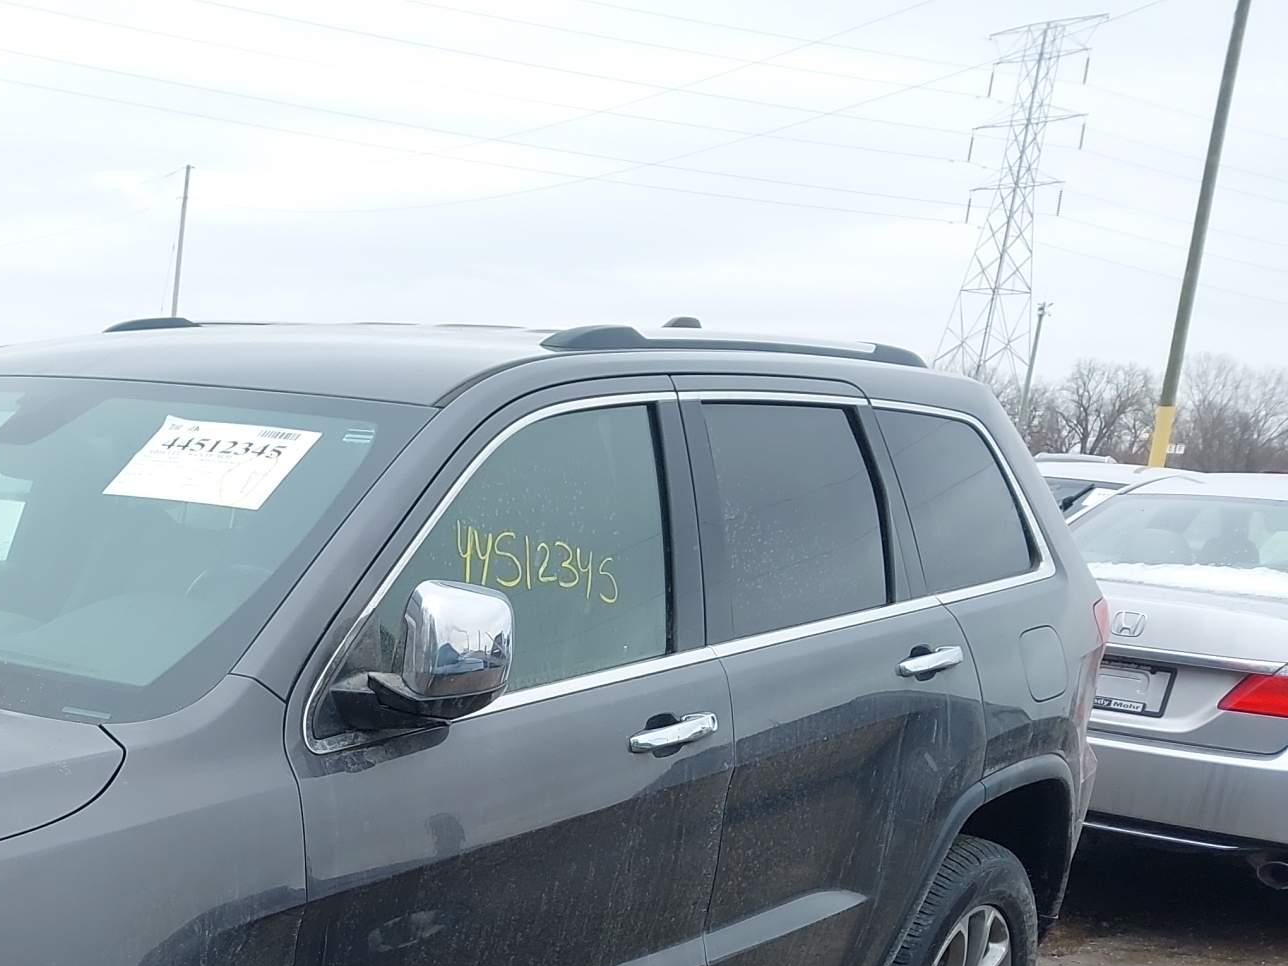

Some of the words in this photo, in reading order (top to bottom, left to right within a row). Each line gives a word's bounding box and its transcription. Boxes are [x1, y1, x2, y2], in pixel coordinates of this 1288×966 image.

[162, 436, 289, 459] 44512345
[457, 519, 619, 604] 44512345
[1112, 701, 1142, 711] Mohr
